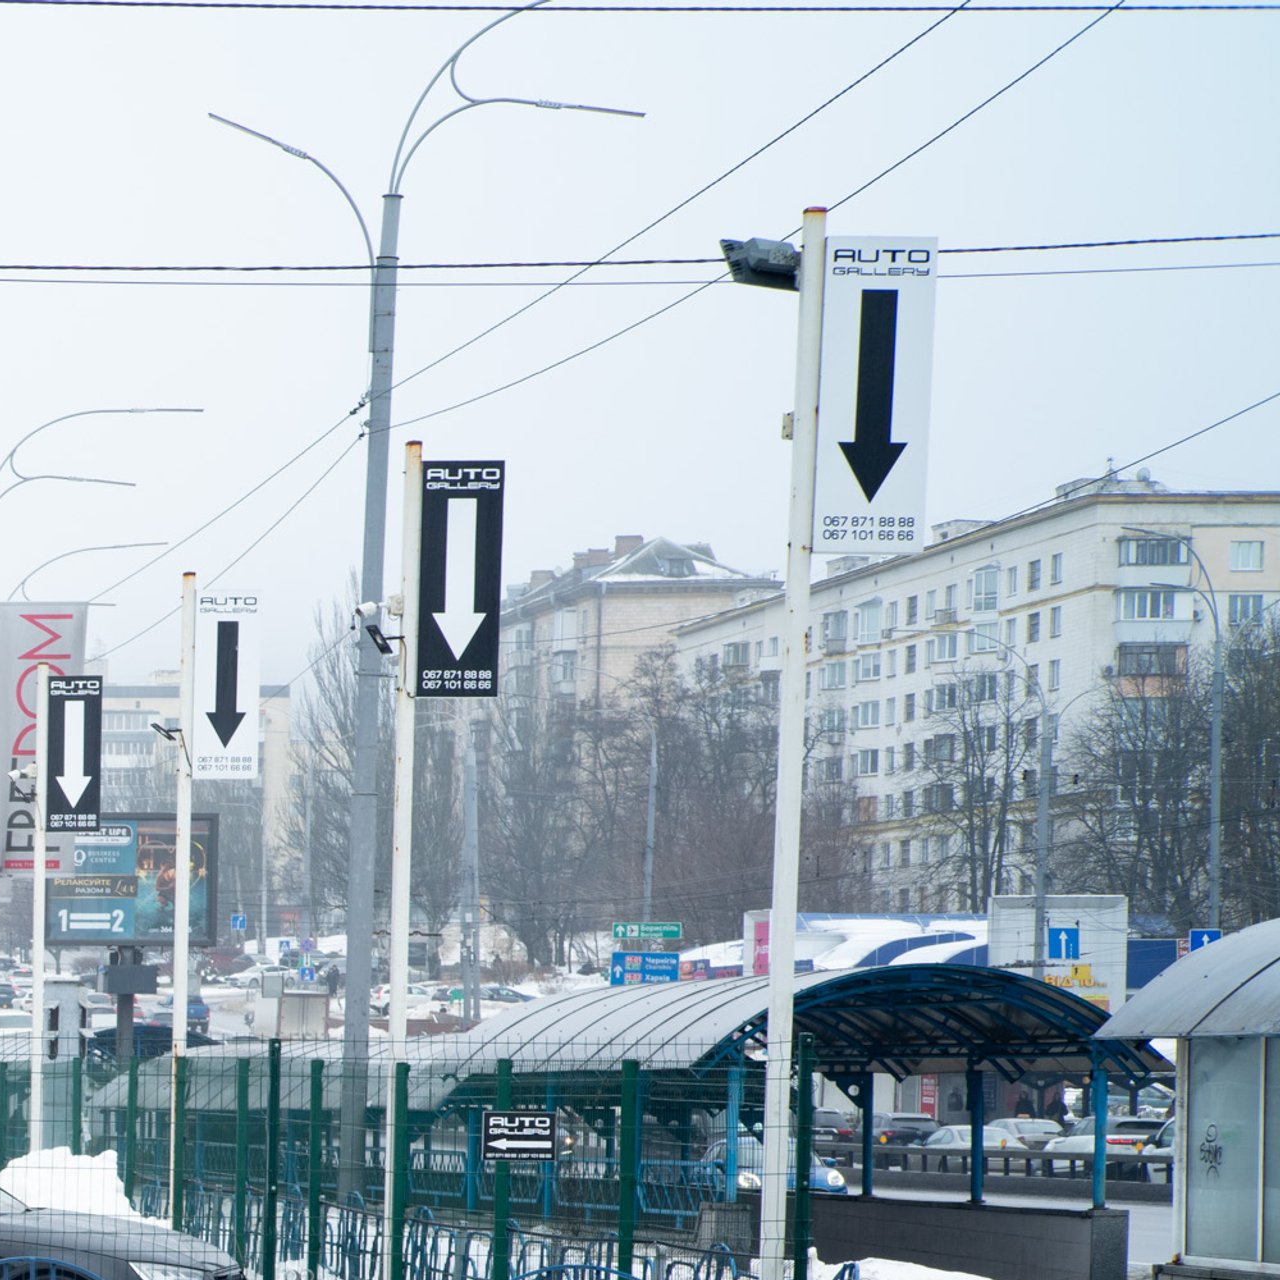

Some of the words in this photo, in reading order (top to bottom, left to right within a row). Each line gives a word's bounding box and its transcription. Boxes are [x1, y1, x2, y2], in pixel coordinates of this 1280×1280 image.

[833, 248, 931, 264] AUTO
[832, 266, 931, 277] GALLERY
[426, 468, 501, 480] AUTO
[426, 481, 501, 490] GALLERY
[822, 515, 848, 527] 067
[851, 516, 875, 527] 871
[878, 517, 895, 528] 88
[898, 517, 916, 528] 88
[822, 529, 848, 540] 067
[851, 530, 874, 540] 101
[878, 530, 895, 541] 66
[897, 530, 915, 541] 66
[200, 596, 258, 606] AUTO
[422, 670, 442, 680] 067
[443, 670, 462, 680] 871
[464, 670, 477, 680] 88
[478, 670, 492, 680] 88
[50, 680, 100, 689] AUTO
[422, 680, 442, 690] 067
[444, 680, 461, 690] 101
[478, 680, 492, 690] 66
[488, 1116, 551, 1128] AUTO
[488, 1127, 551, 1136] GALLERY
